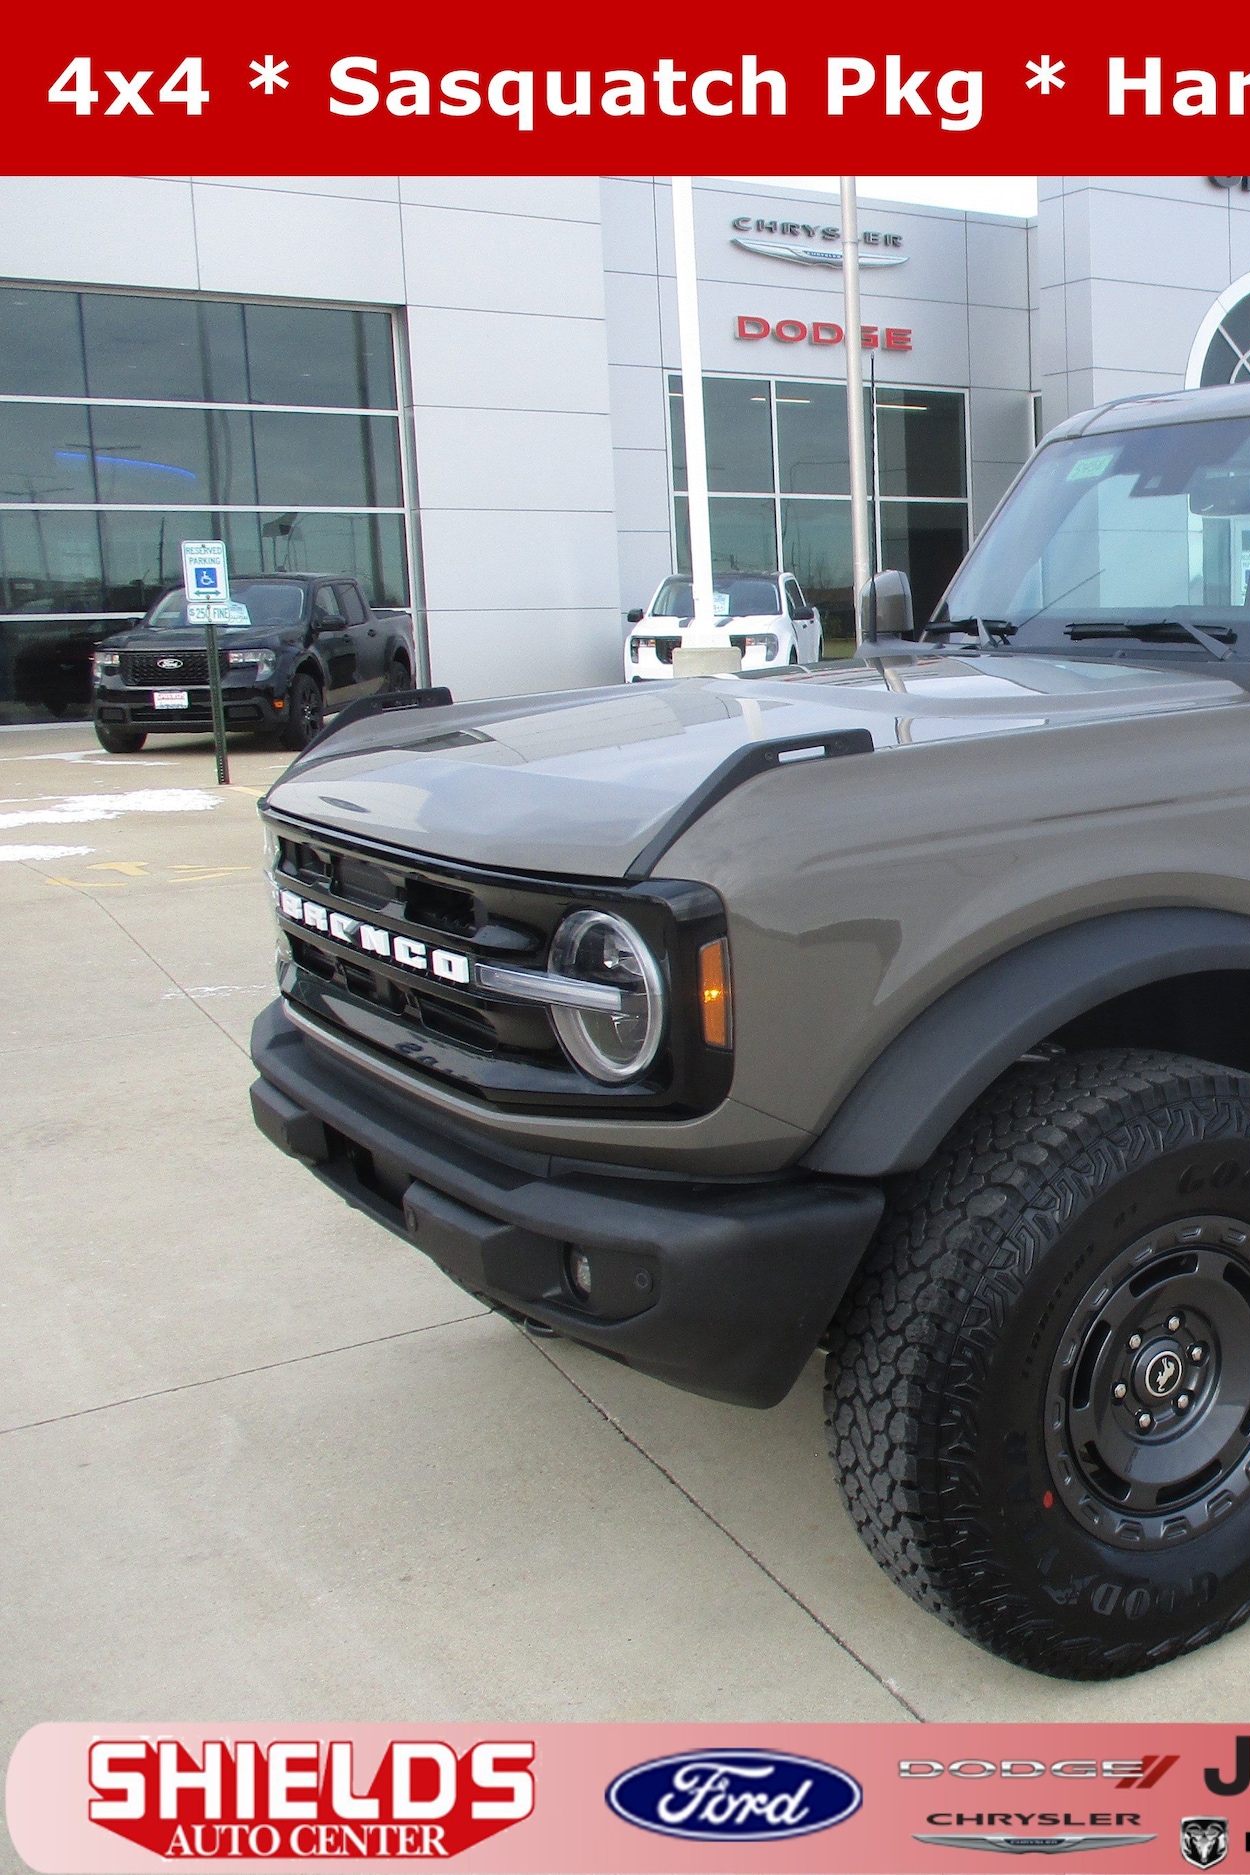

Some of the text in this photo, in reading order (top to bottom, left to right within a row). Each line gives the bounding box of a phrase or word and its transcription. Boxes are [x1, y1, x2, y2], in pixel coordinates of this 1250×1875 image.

[732, 217, 903, 247] CHRYSER
[185, 546, 222, 554] RESERVED
[188, 556, 221, 565] PARKING
[213, 607, 230, 619] FINE
